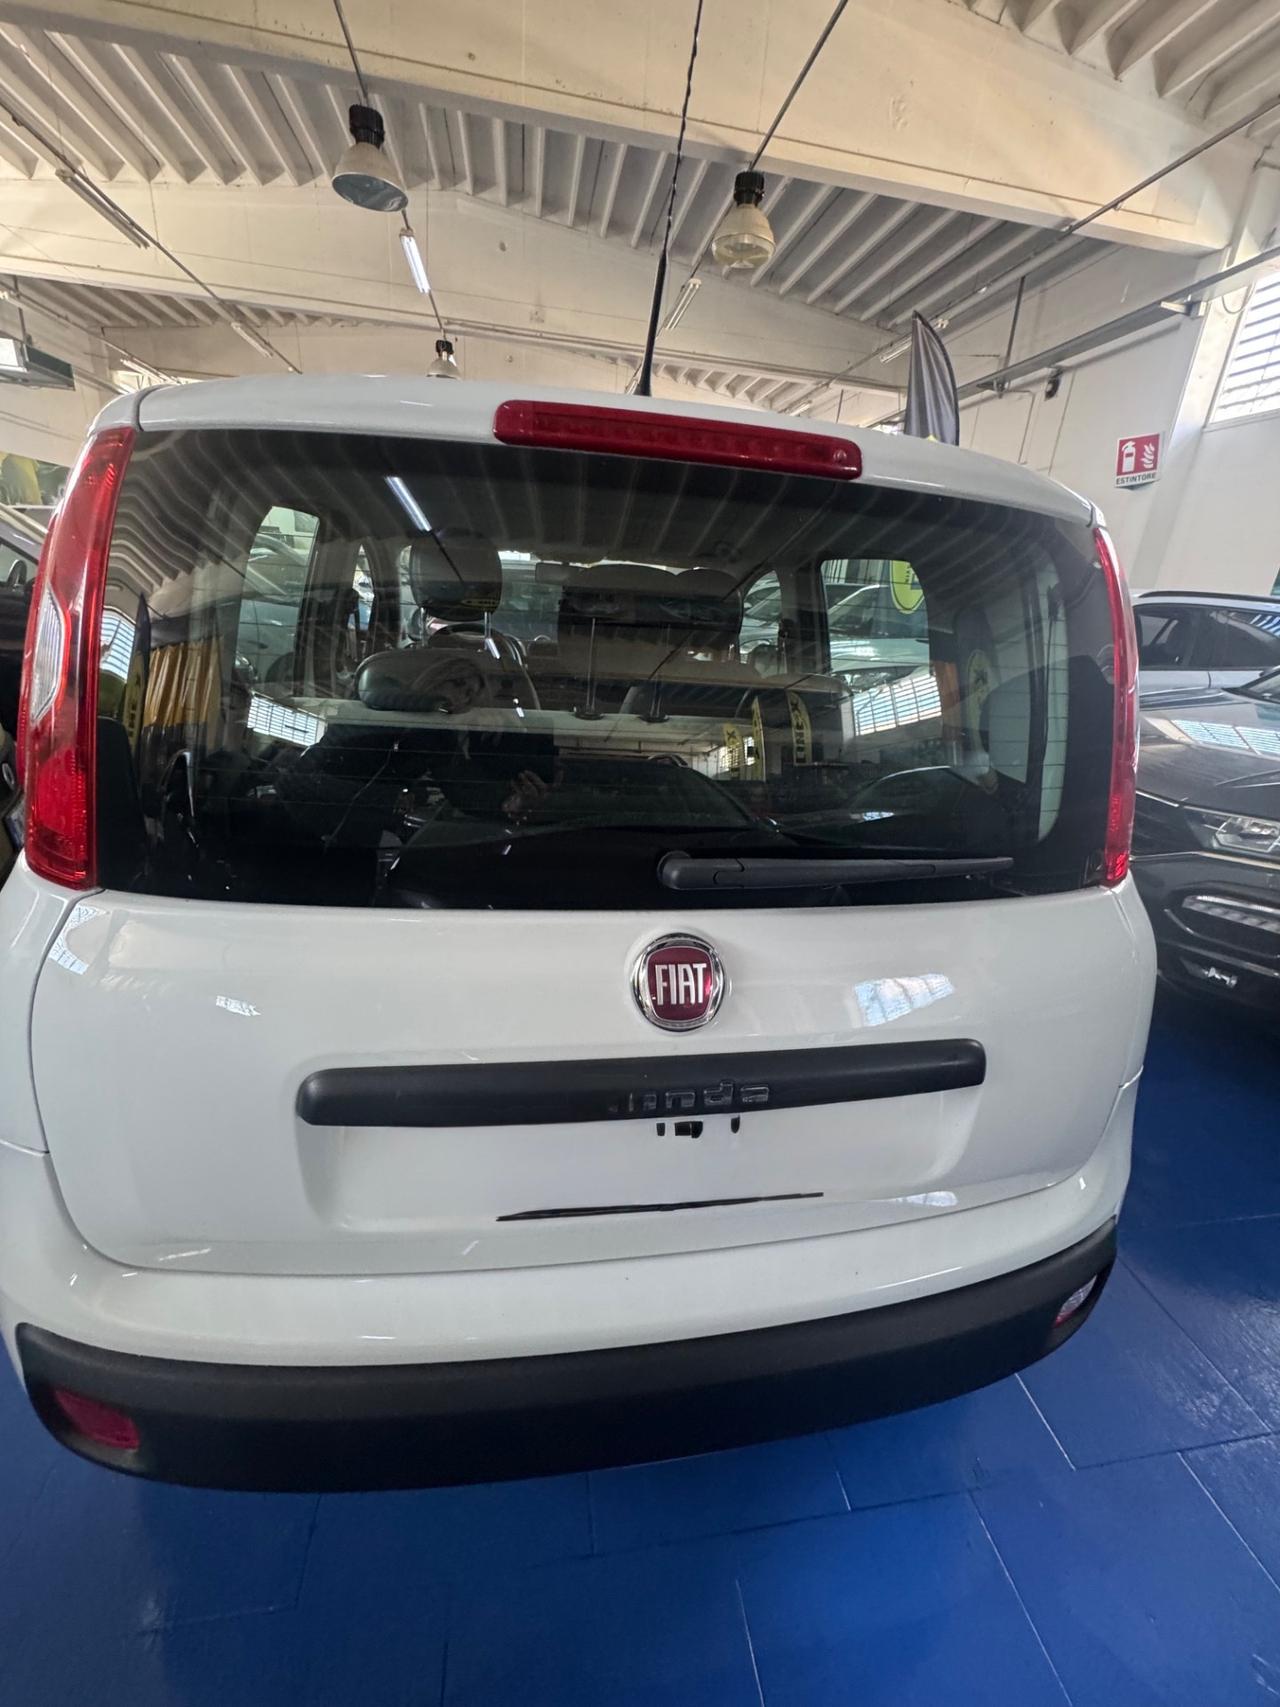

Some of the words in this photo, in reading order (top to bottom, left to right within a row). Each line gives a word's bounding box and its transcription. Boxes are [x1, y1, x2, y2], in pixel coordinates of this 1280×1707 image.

[1115, 473, 1156, 485] ESTINTORE
[655, 963, 707, 1006] FIAT
[607, 1081, 769, 1112] anda
